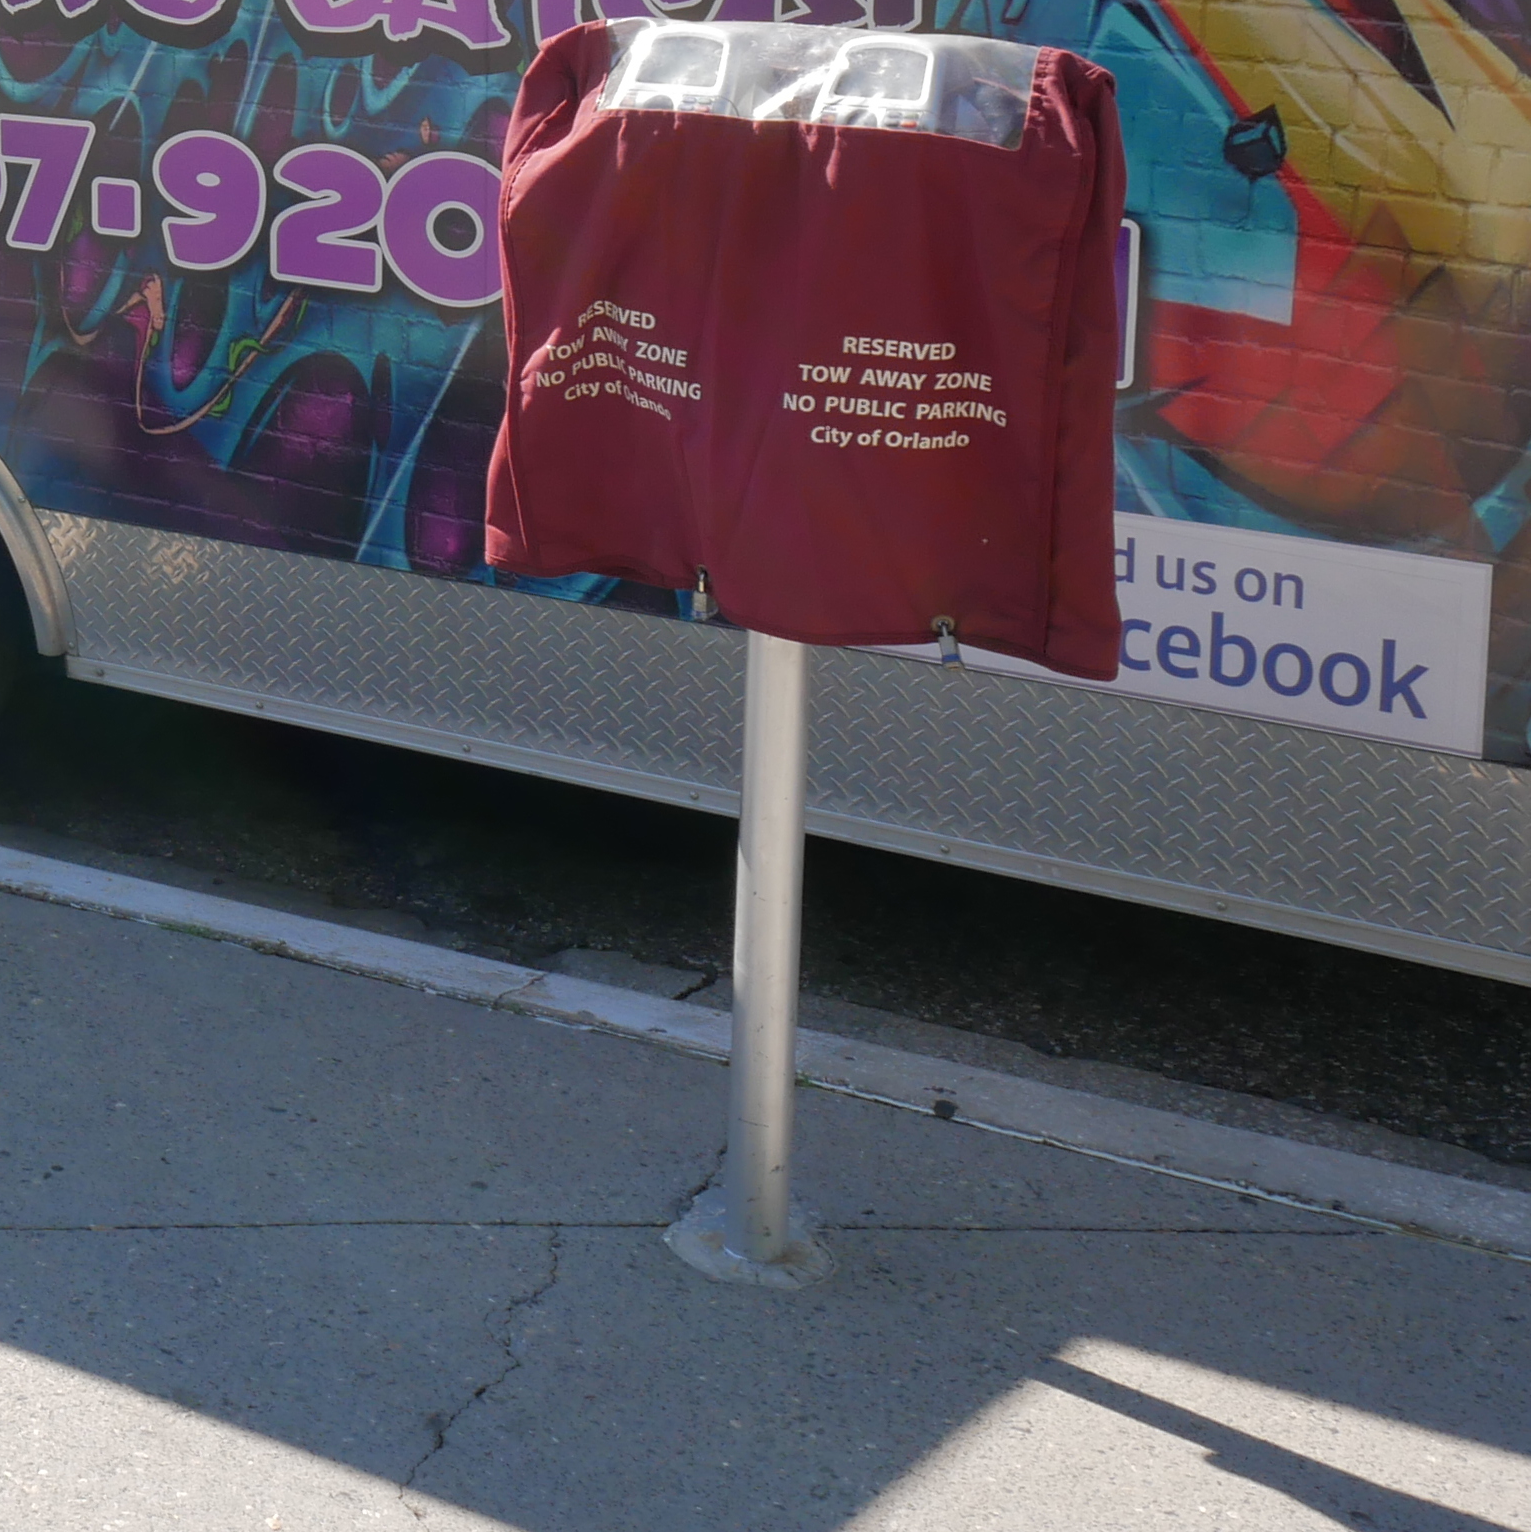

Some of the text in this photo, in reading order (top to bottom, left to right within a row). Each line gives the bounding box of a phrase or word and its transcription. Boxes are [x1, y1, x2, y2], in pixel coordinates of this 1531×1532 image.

[577, 299, 657, 330] RESERVED
[547, 326, 689, 367] TOW AWAY ZONE
[842, 336, 957, 361] RESERVED
[535, 352, 703, 400] NO PUBLIC PARKING
[798, 363, 993, 393] TOW AWAY ZONE
[564, 379, 672, 421] City of Orlando
[782, 392, 1008, 428] NO PUBLIC PARKING
[810, 425, 971, 450] City of Orlando
[1155, 554, 1218, 596] us
[1233, 565, 1305, 610] on
[1119, 611, 1431, 720] cebook
